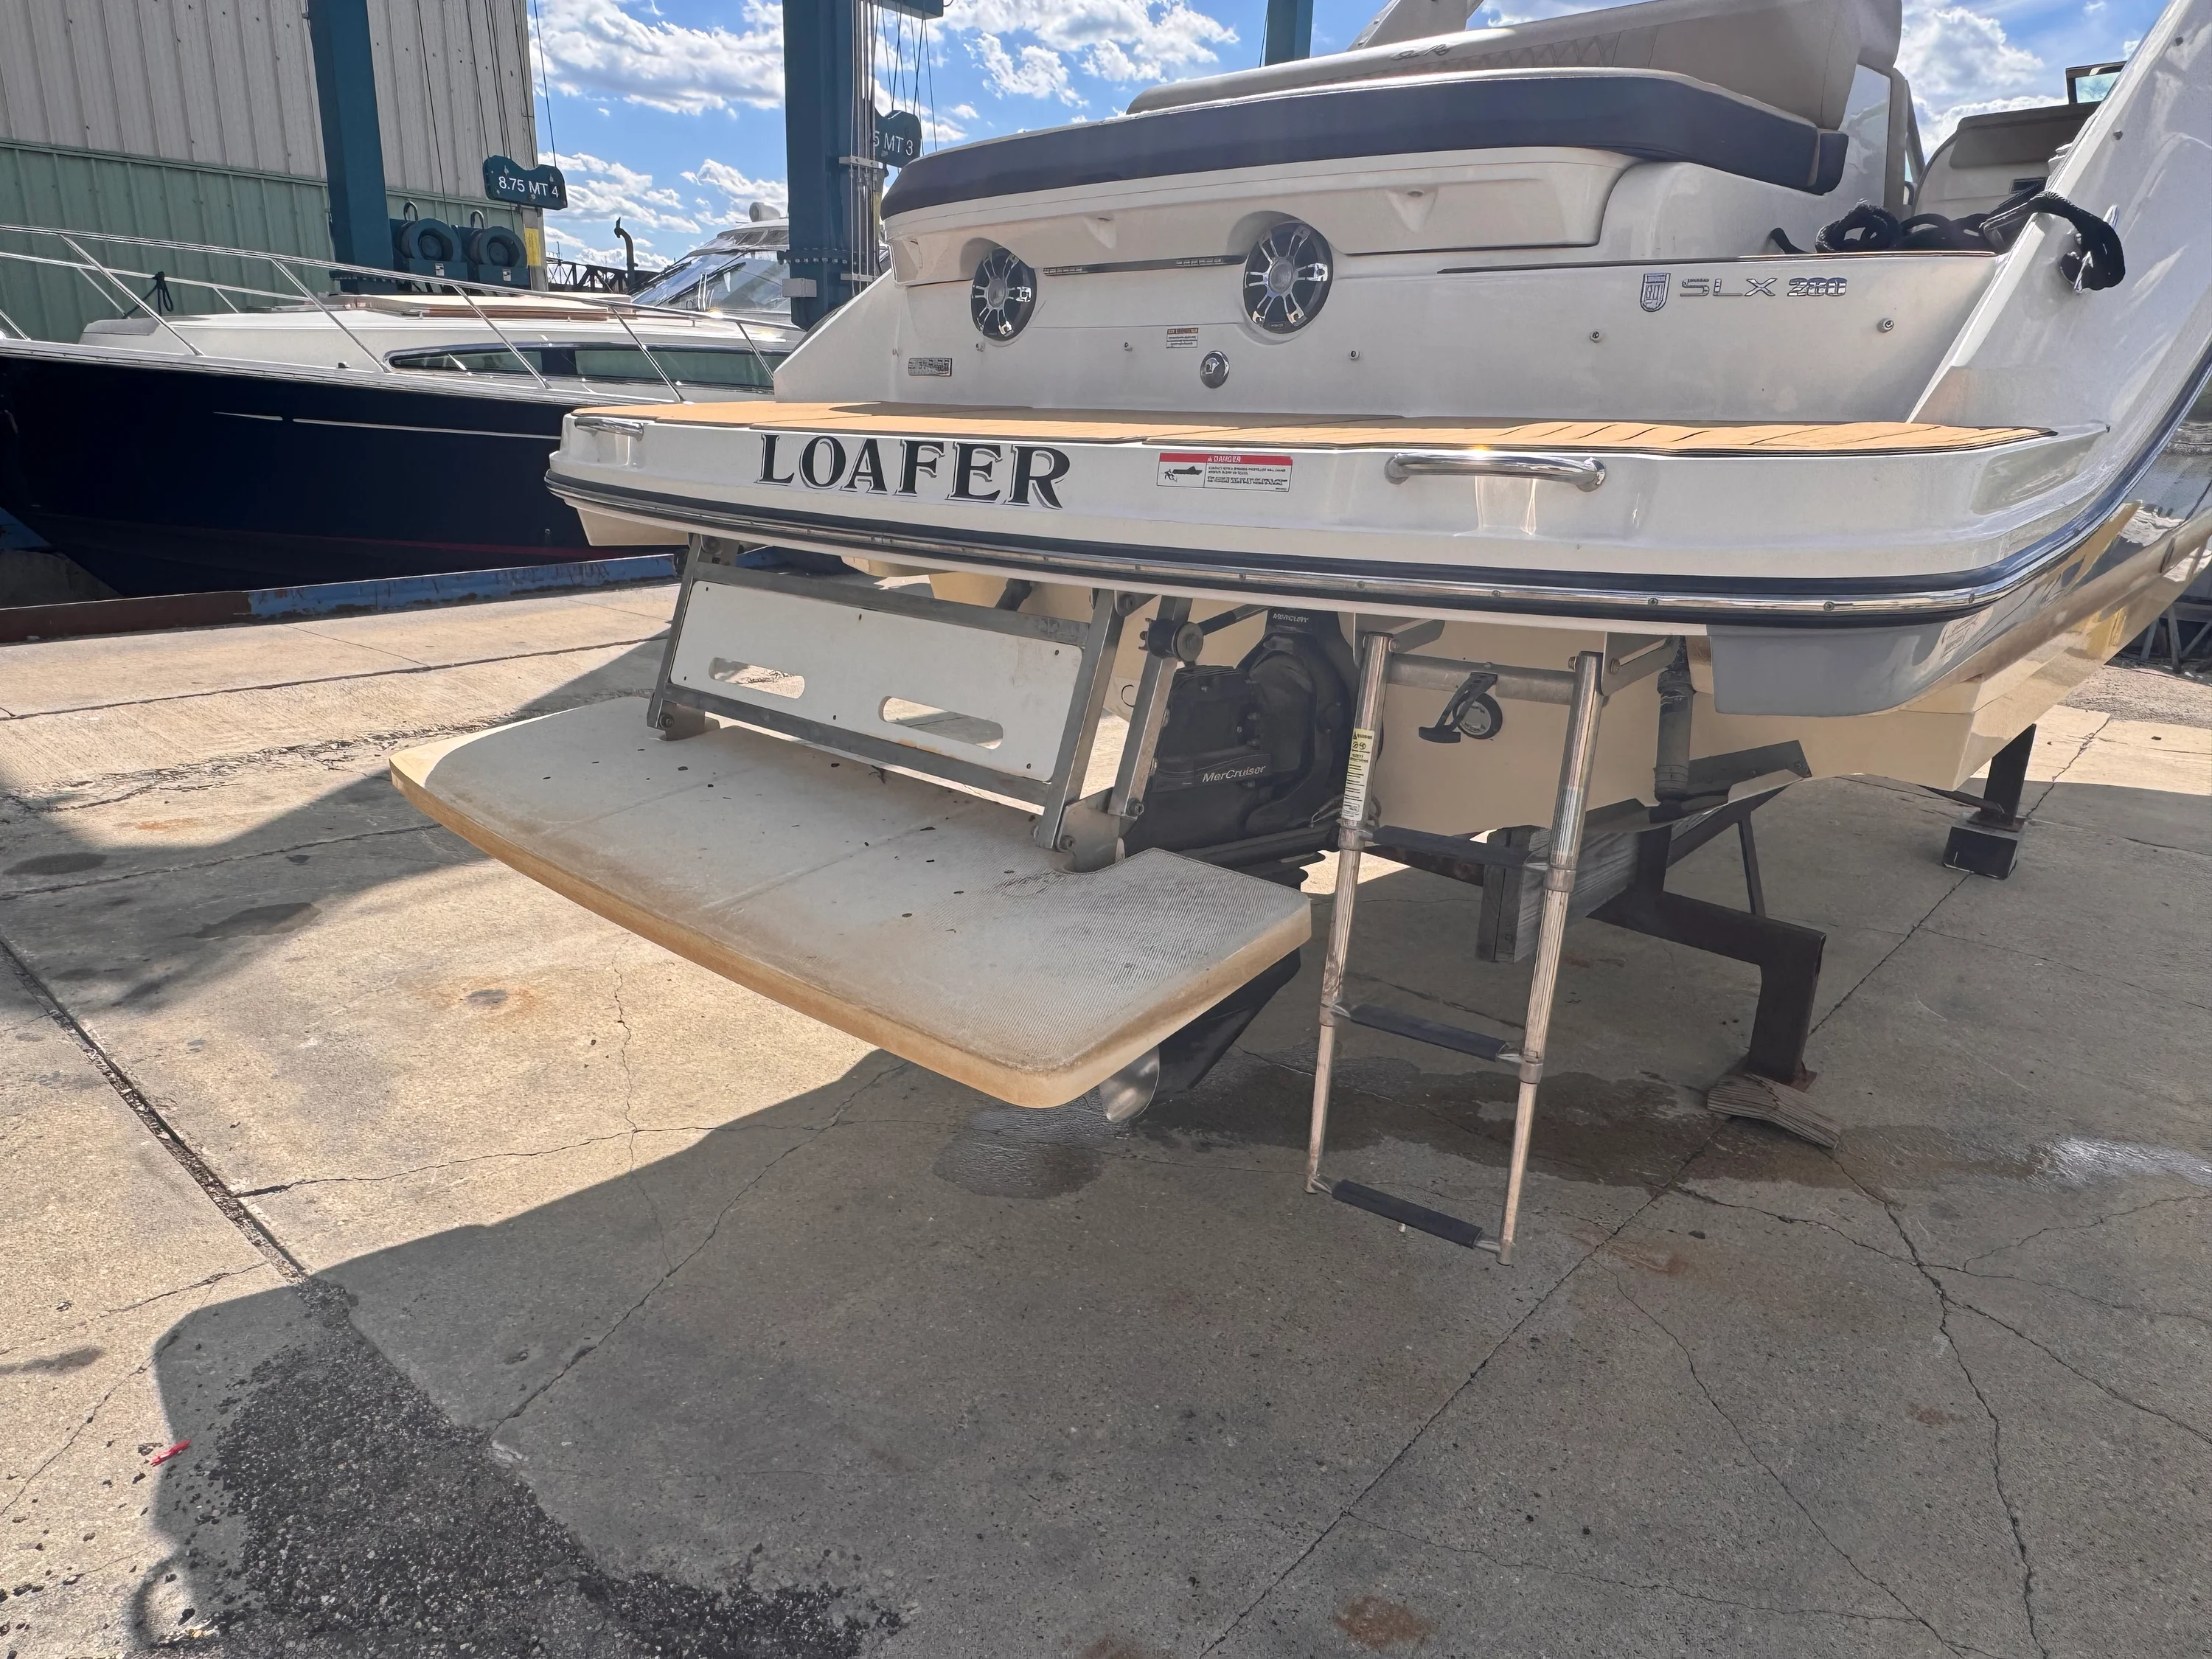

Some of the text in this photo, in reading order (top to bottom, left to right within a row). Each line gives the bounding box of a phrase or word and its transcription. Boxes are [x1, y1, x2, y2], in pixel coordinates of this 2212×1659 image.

[884, 133, 904, 153] MT
[905, 139, 914, 156] 3
[498, 176, 559, 198] 8.75 MT 4
[1680, 277, 1778, 297] SLX
[1214, 455, 1241, 463] DANGER
[754, 434, 1071, 510] LOAFER
[1273, 613, 1310, 623] MERCURY
[1202, 765, 1266, 783] MerCruiser
